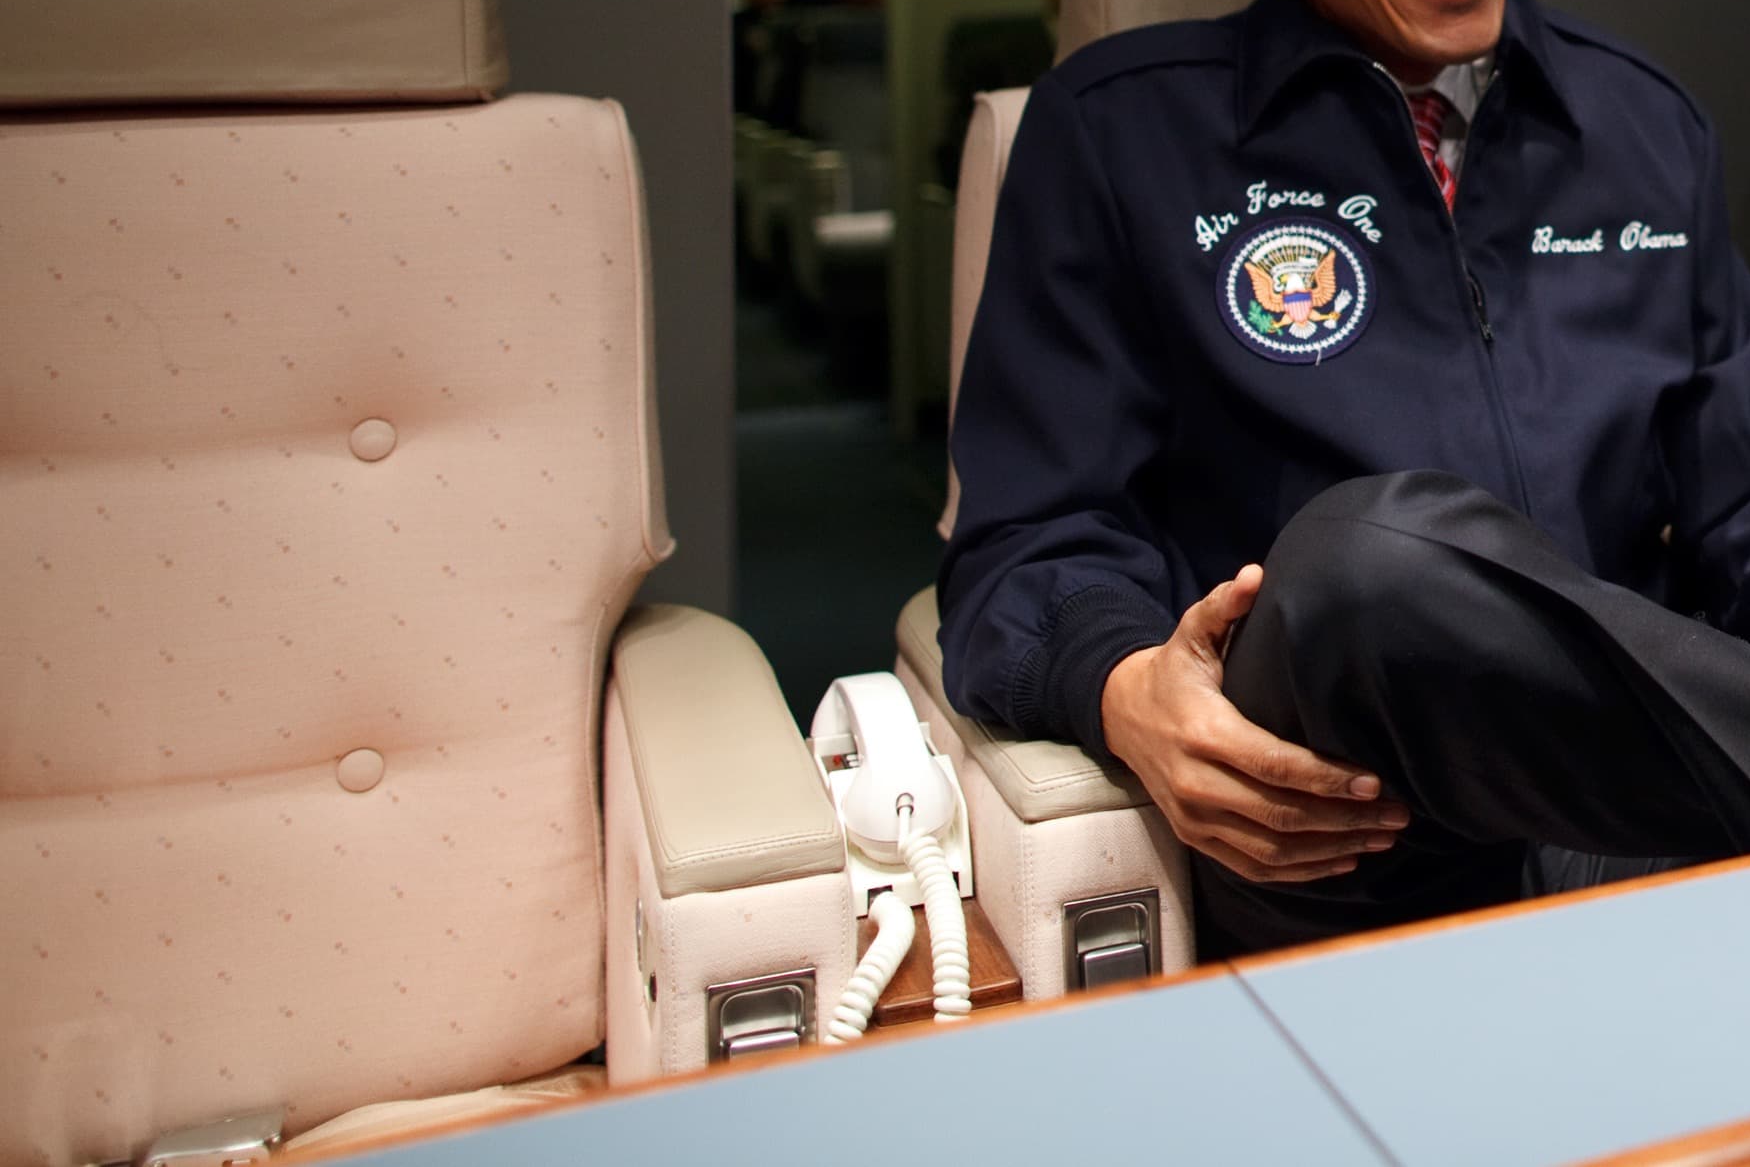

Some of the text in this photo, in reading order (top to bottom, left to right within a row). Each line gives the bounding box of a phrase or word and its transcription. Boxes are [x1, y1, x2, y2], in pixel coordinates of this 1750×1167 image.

[1195, 180, 1383, 252] Air Force One
[1531, 221, 1689, 254] Barack Obama
